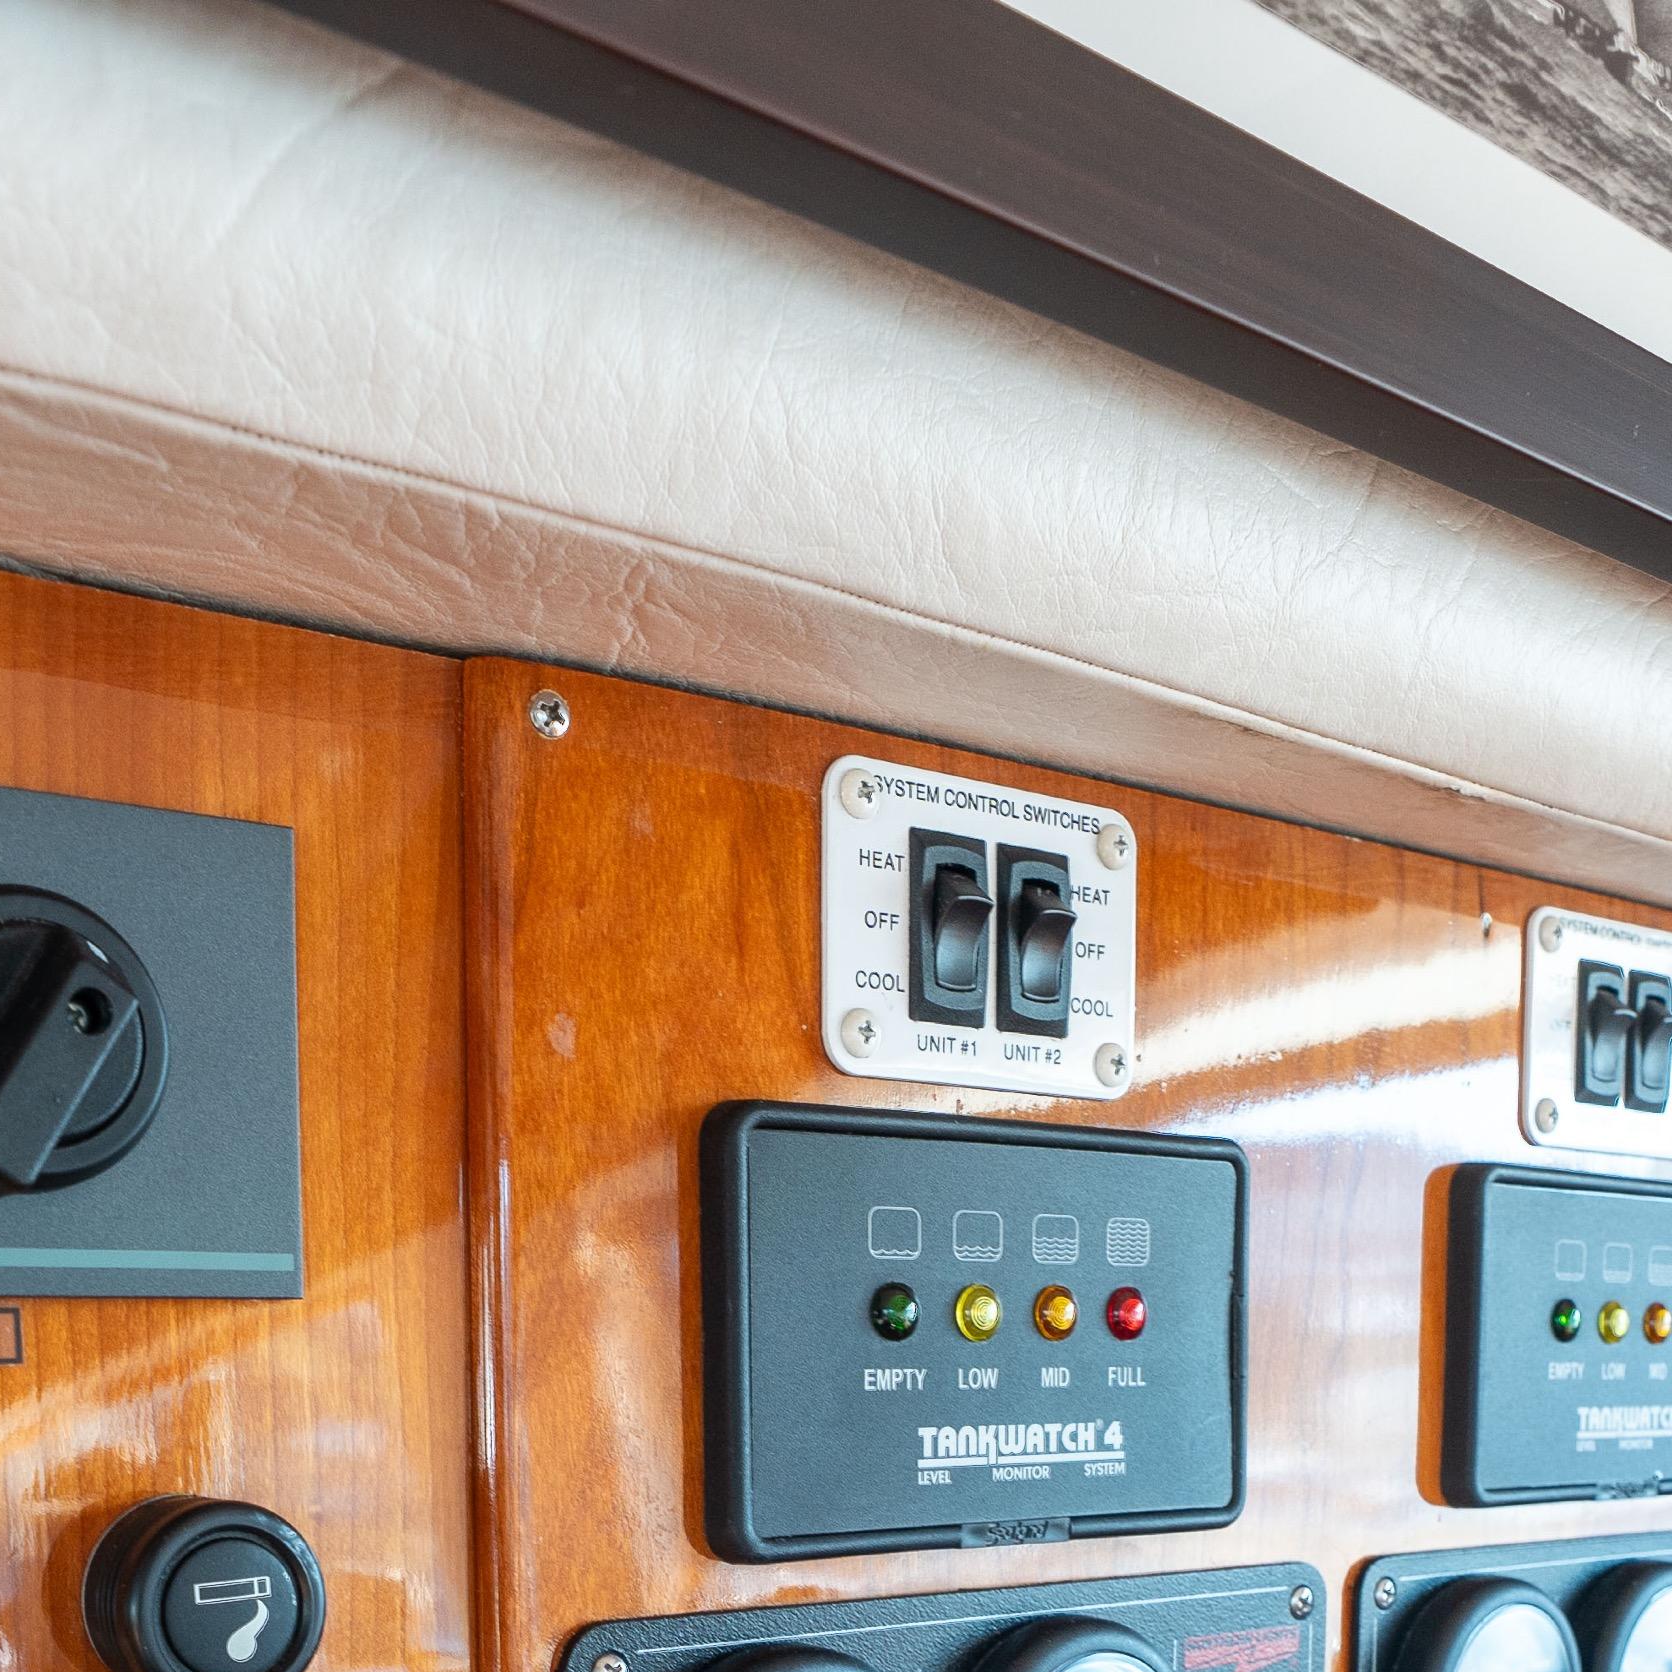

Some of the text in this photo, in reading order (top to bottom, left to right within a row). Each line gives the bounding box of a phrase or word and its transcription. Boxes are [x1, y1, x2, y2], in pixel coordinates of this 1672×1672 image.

[873, 775, 1101, 835] SYSTEM CONTROL SWITCHES
[859, 848, 905, 872] HEAT
[1071, 885, 1111, 906] HEAT
[864, 910, 900, 931] OFF
[1075, 941, 1105, 960] OFF
[855, 970, 905, 993] COOL
[1071, 997, 1114, 1018] COOL
[917, 1034, 977, 1057] UNIT #1
[1003, 1043, 1062, 1065] UNIT #2
[863, 1368, 927, 1391] EMPTY
[958, 1368, 999, 1390] LOW
[1041, 1367, 1070, 1388] MID
[1108, 1366, 1146, 1387] FULL
[1548, 1362, 1585, 1381] EMPTY
[1601, 1362, 1626, 1381] LOW
[1104, 1420, 1124, 1450] 4
[918, 1462, 1126, 1486] LEVEL MONITOR SYSTEM
